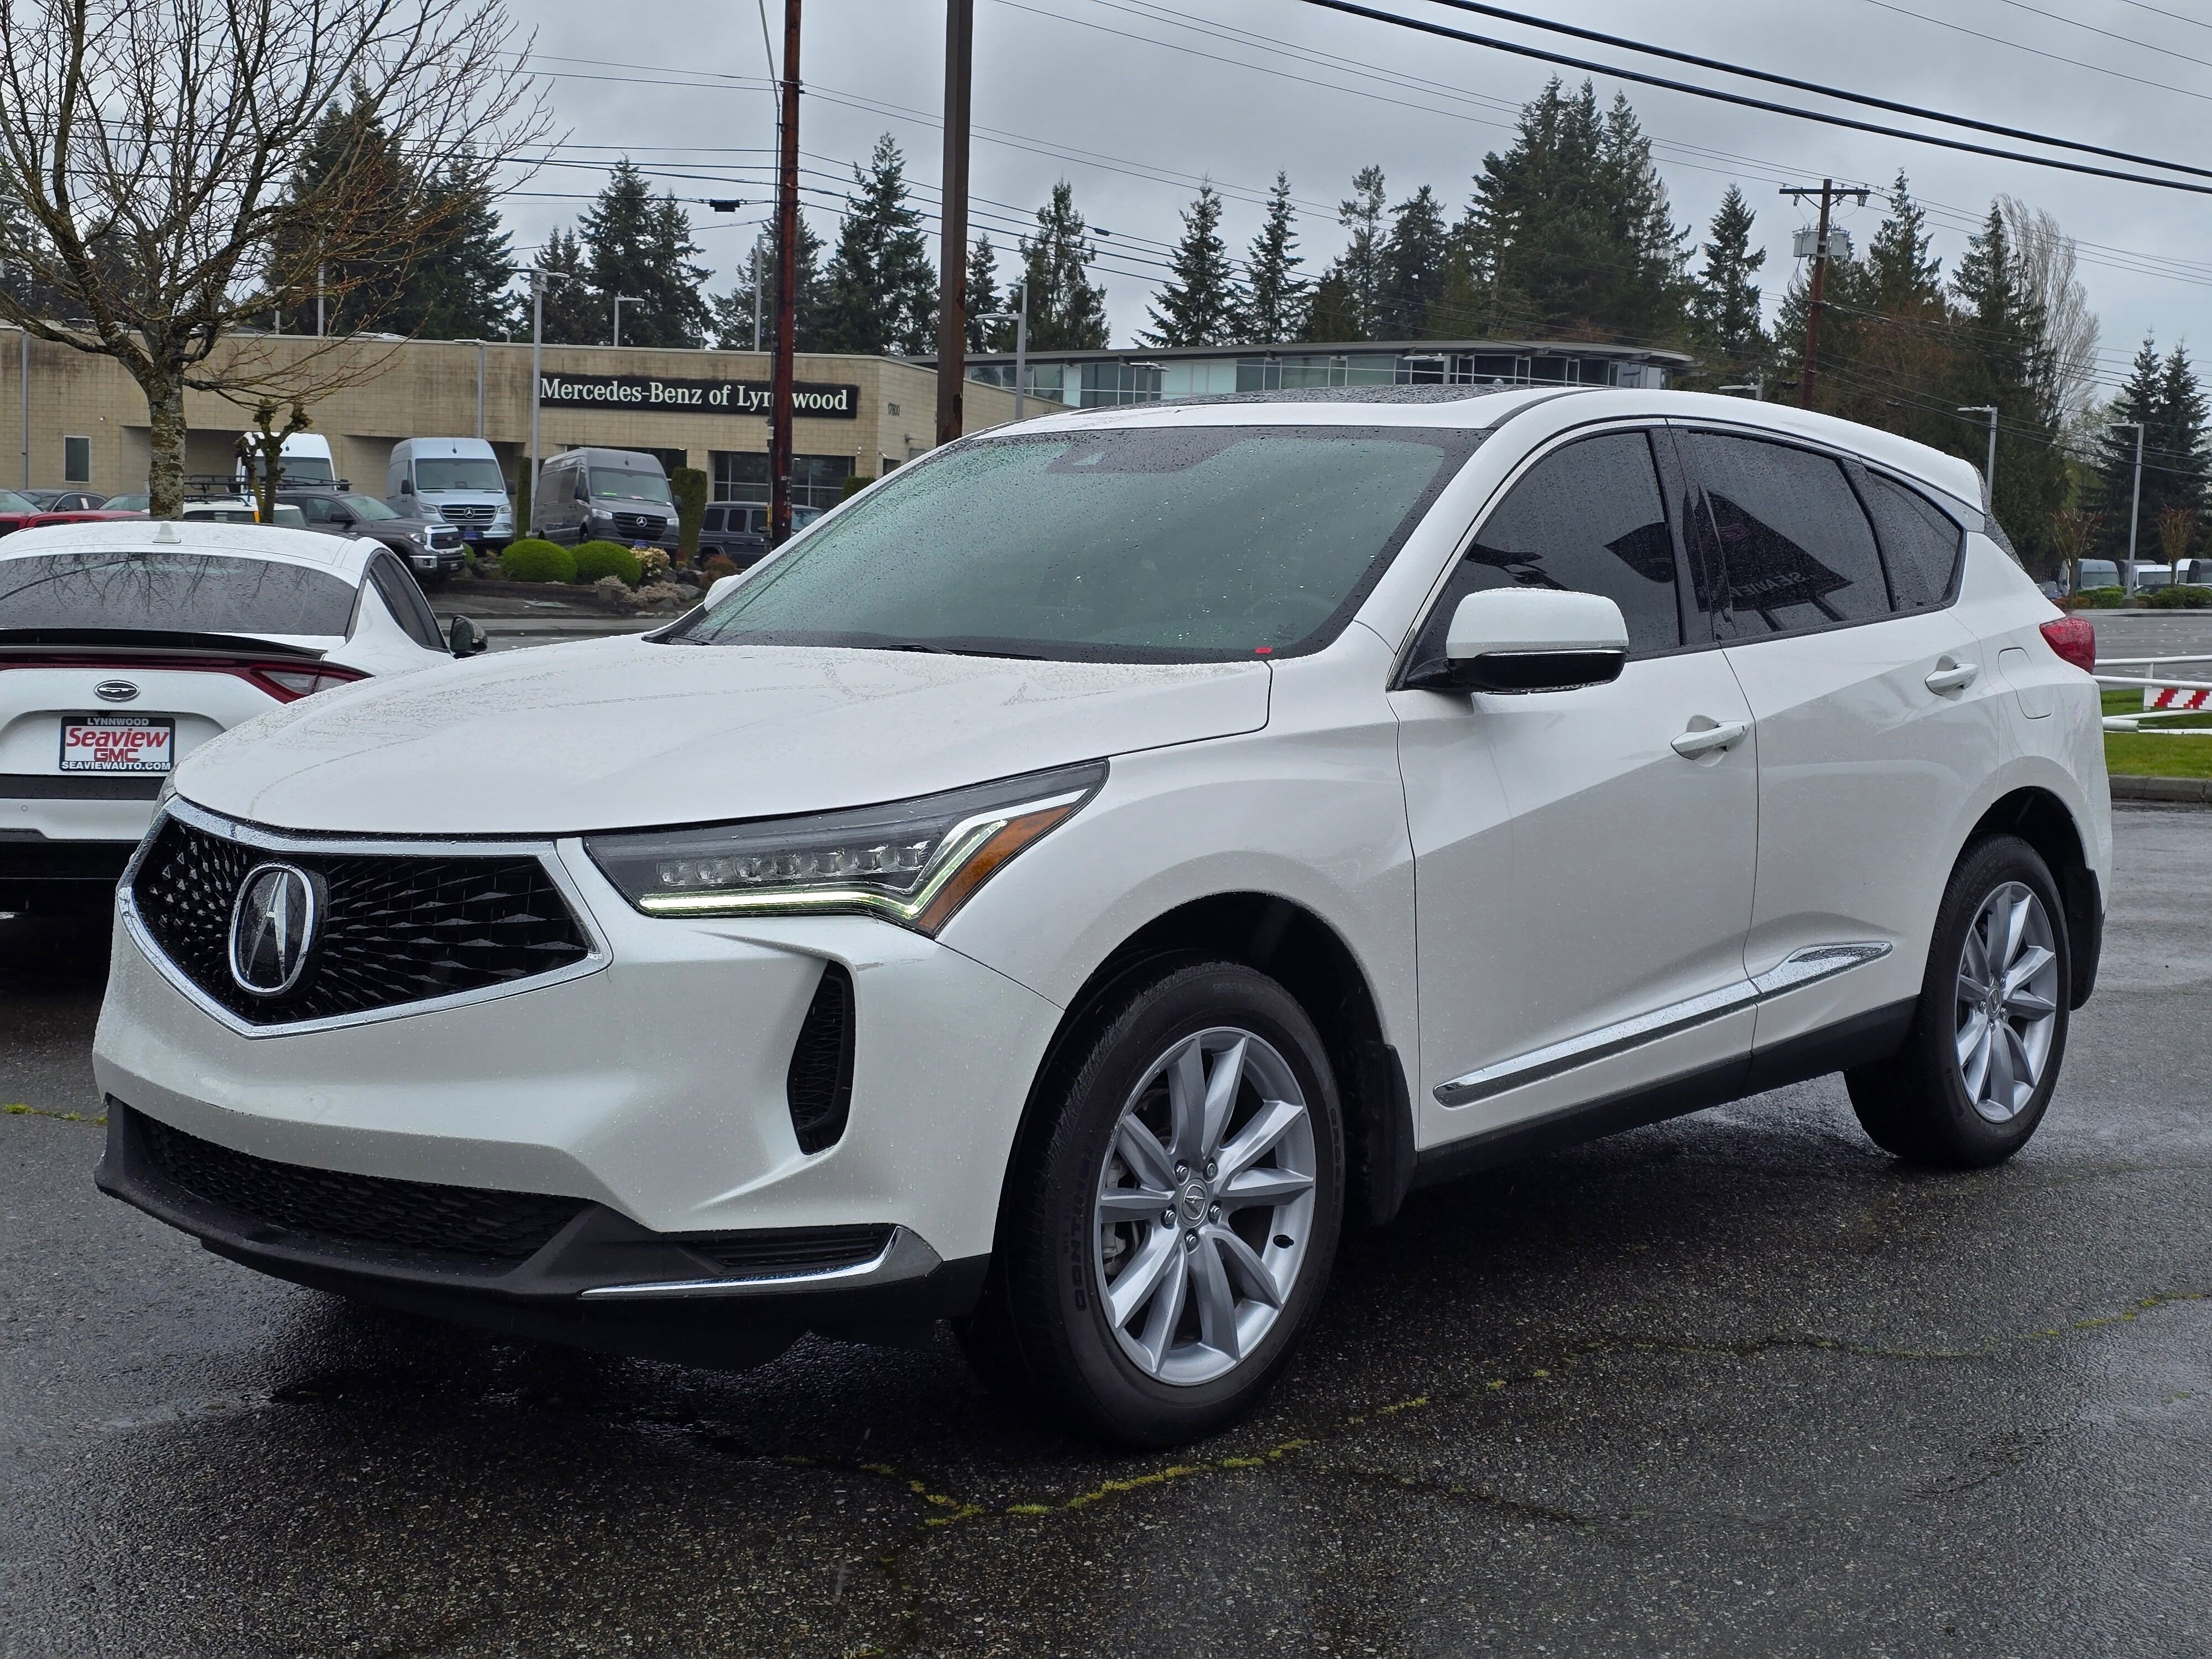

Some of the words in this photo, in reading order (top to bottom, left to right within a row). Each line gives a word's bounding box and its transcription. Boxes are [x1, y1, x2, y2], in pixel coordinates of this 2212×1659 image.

[540, 378, 702, 404] Mercedes-Benz
[709, 385, 731, 405] of
[737, 385, 848, 411] Lynwood
[87, 717, 149, 726] LYNNWOOD
[66, 727, 169, 748] Seaview
[93, 748, 140, 762] GMC
[61, 761, 171, 770] SEAVIEWAUTO.COM
